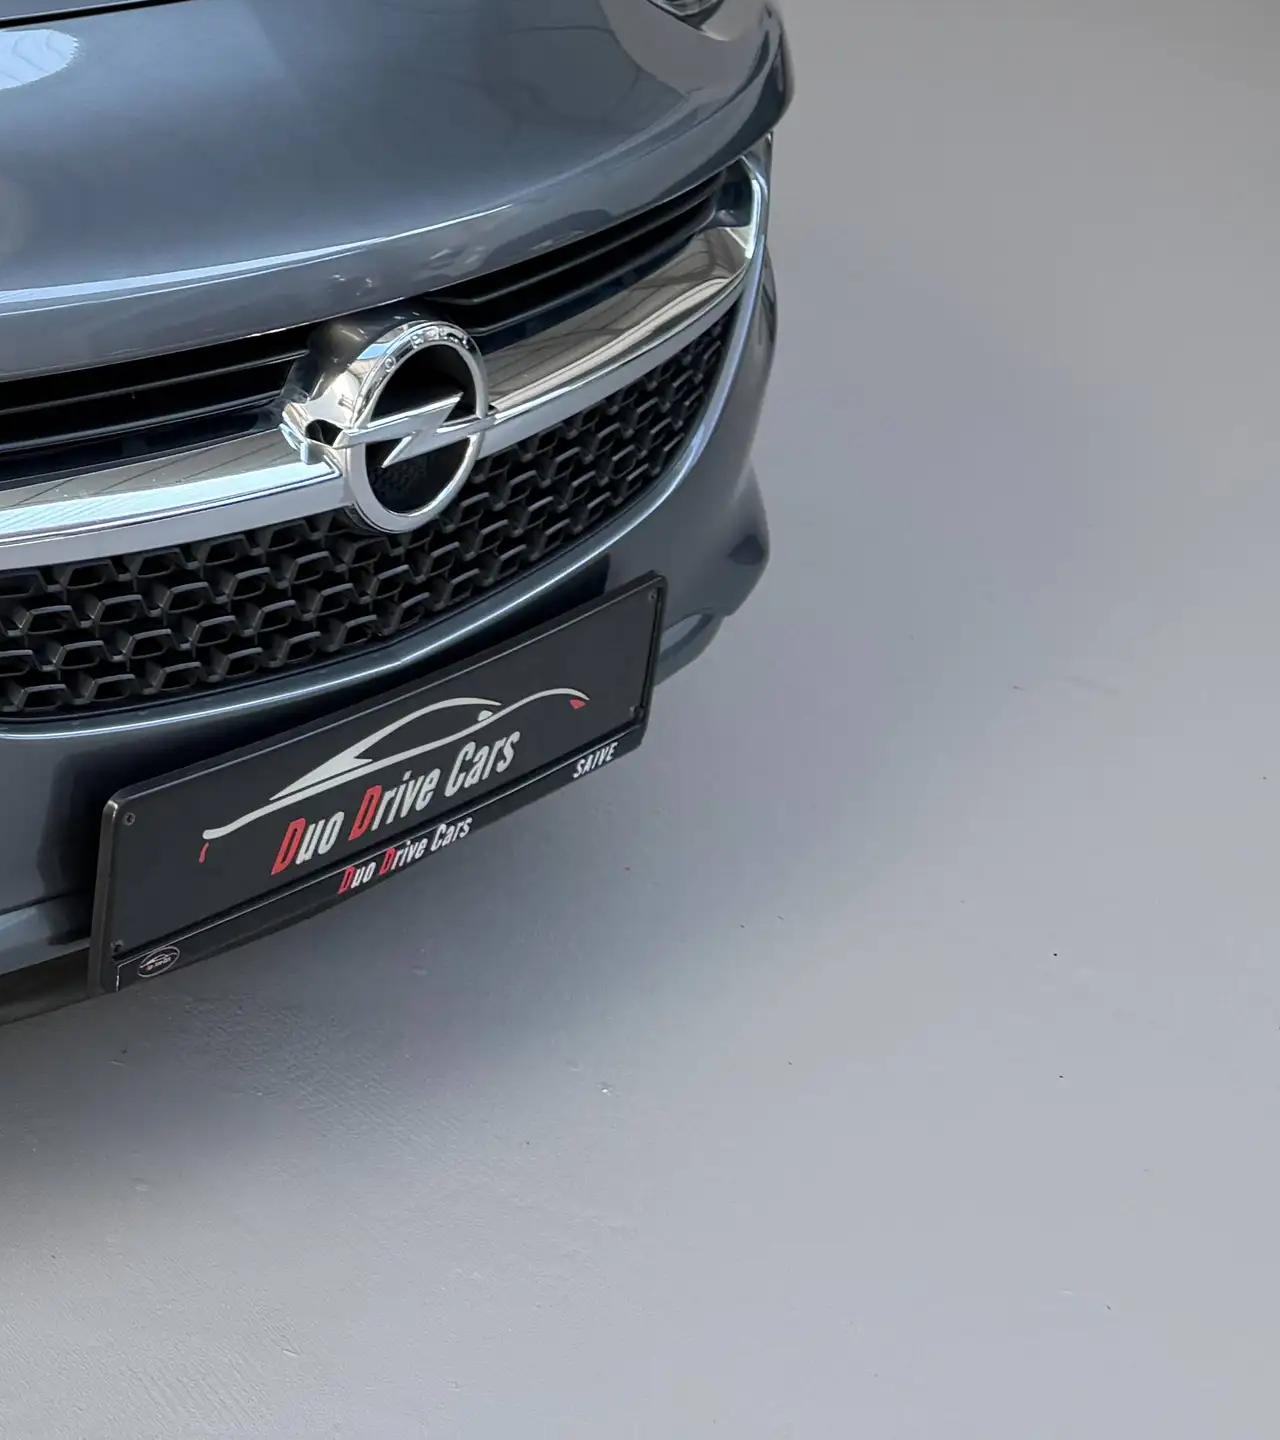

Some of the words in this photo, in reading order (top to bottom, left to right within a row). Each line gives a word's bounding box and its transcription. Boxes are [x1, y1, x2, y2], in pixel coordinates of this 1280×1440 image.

[572, 741, 618, 779] SAIVE
[271, 811, 344, 875] Duo
[348, 769, 440, 841] Drive
[444, 731, 520, 797] Cars
[338, 862, 377, 895] Duo
[378, 837, 428, 876] Drive
[430, 817, 473, 852] Cars
